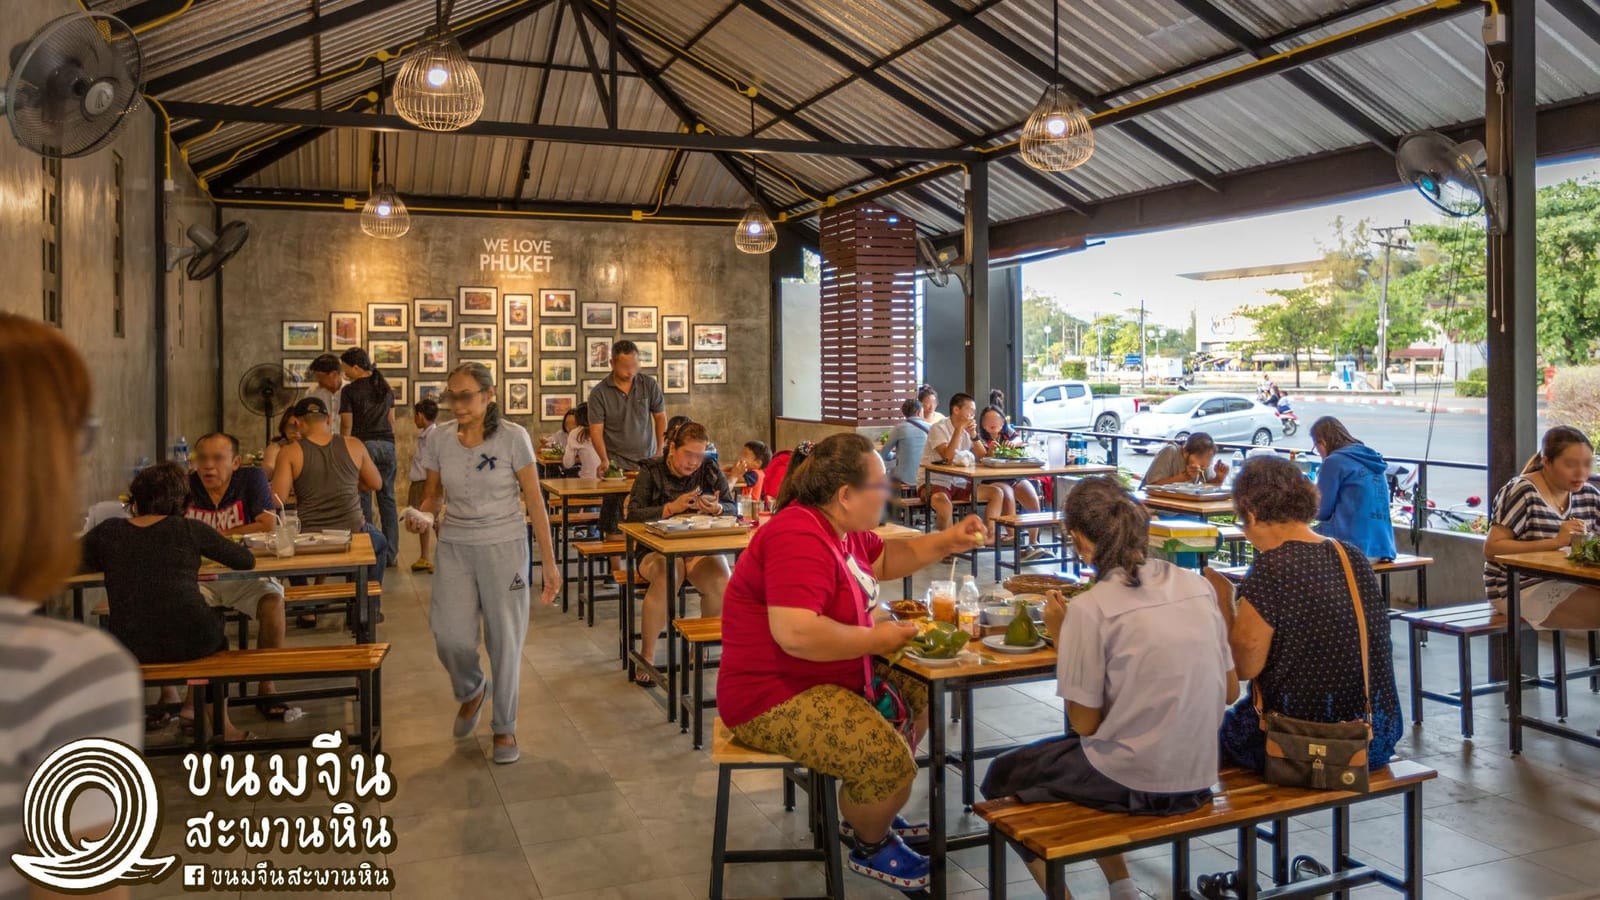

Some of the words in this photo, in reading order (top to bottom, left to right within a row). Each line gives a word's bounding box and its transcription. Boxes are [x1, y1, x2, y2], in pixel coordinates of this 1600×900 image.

[483, 238, 509, 252] WE
[513, 239, 552, 253] LOVE
[479, 253, 554, 273] PHUKET
